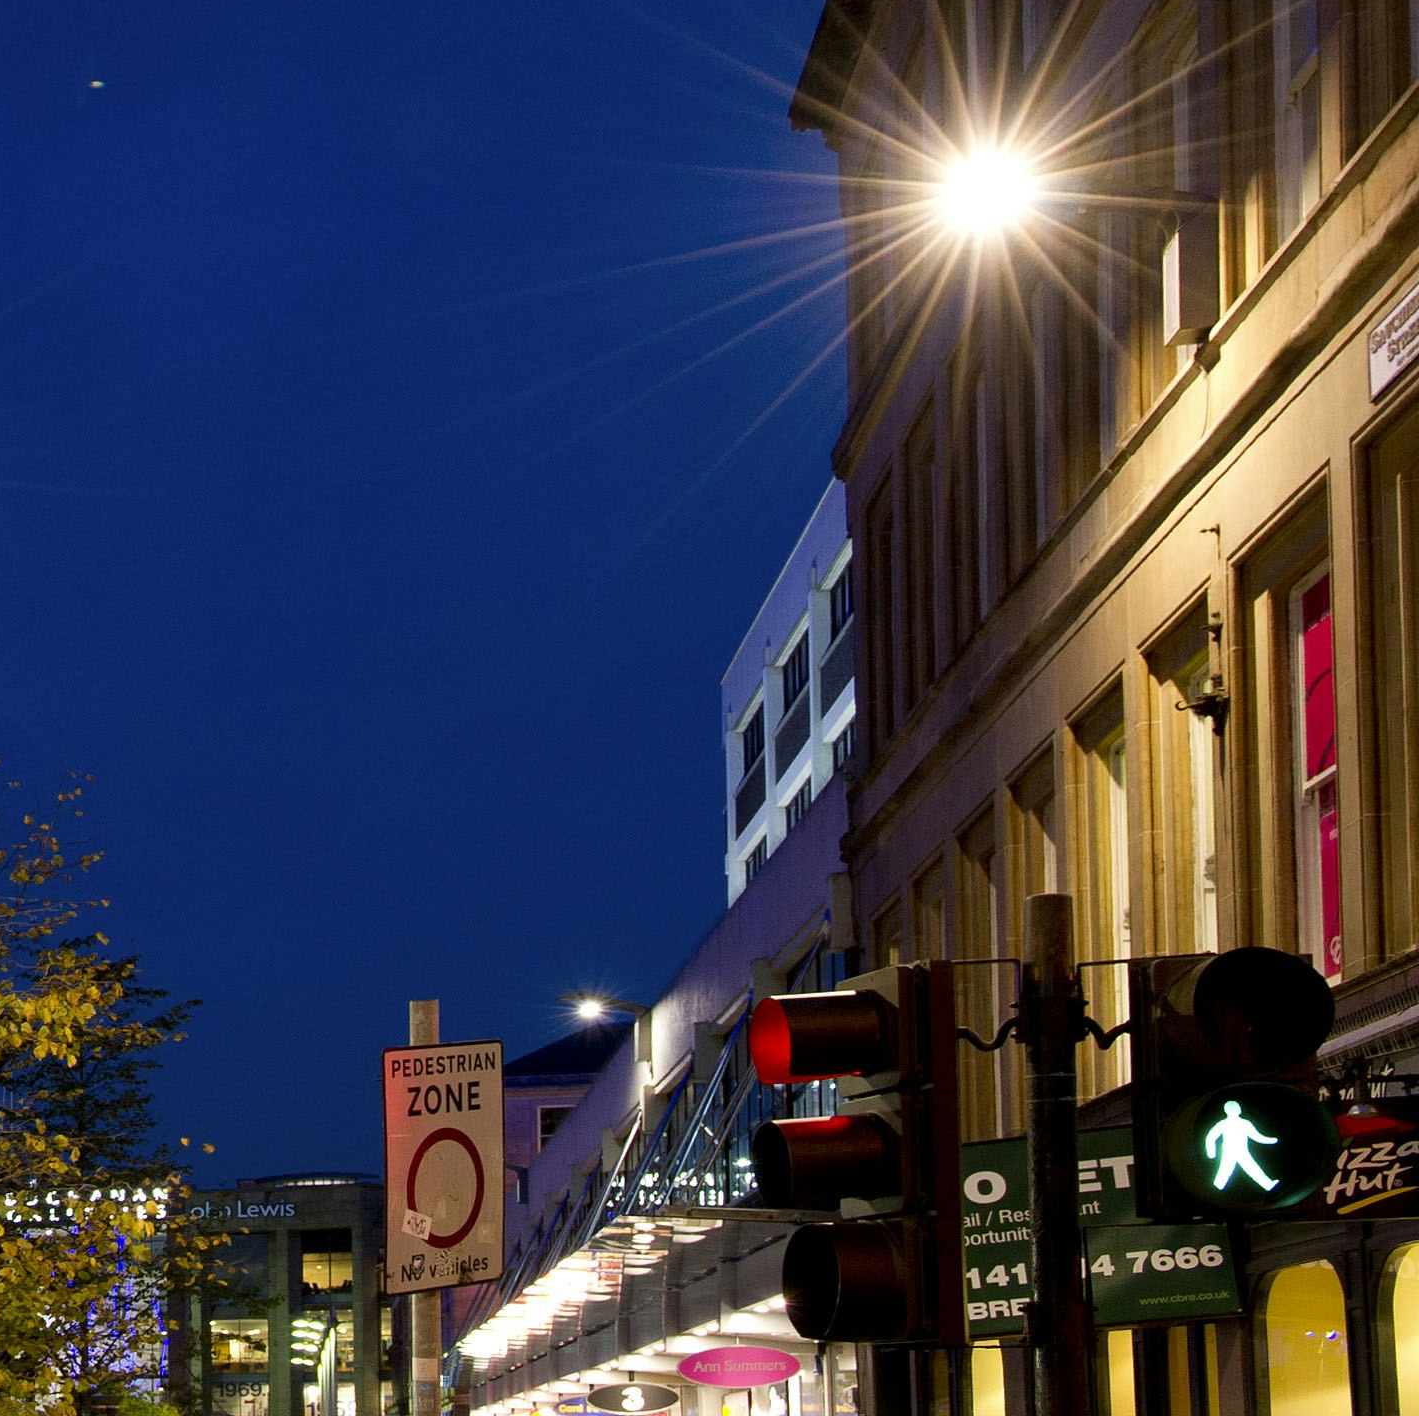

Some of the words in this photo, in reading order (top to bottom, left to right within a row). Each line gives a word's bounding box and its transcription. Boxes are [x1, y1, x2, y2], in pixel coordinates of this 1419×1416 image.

[391, 1051, 496, 1078] PEDESTRIAN
[407, 1081, 481, 1116] ZONE
[1336, 1137, 1419, 1170] izza
[963, 1170, 1007, 1204] O
[1077, 1154, 1135, 1193] ET
[237, 1199, 296, 1218] Lewis
[429, 1255, 489, 1277] vicles
[965, 1262, 1028, 1289] 141
[1125, 1244, 1224, 1274] 7666
[966, 1297, 1031, 1321] BRE
[1139, 1289, 1230, 1306] www.cbre.co.uk
[693, 1360, 721, 1373] Ann
[724, 1359, 787, 1373] Summers
[620, 1386, 645, 1411] 3
